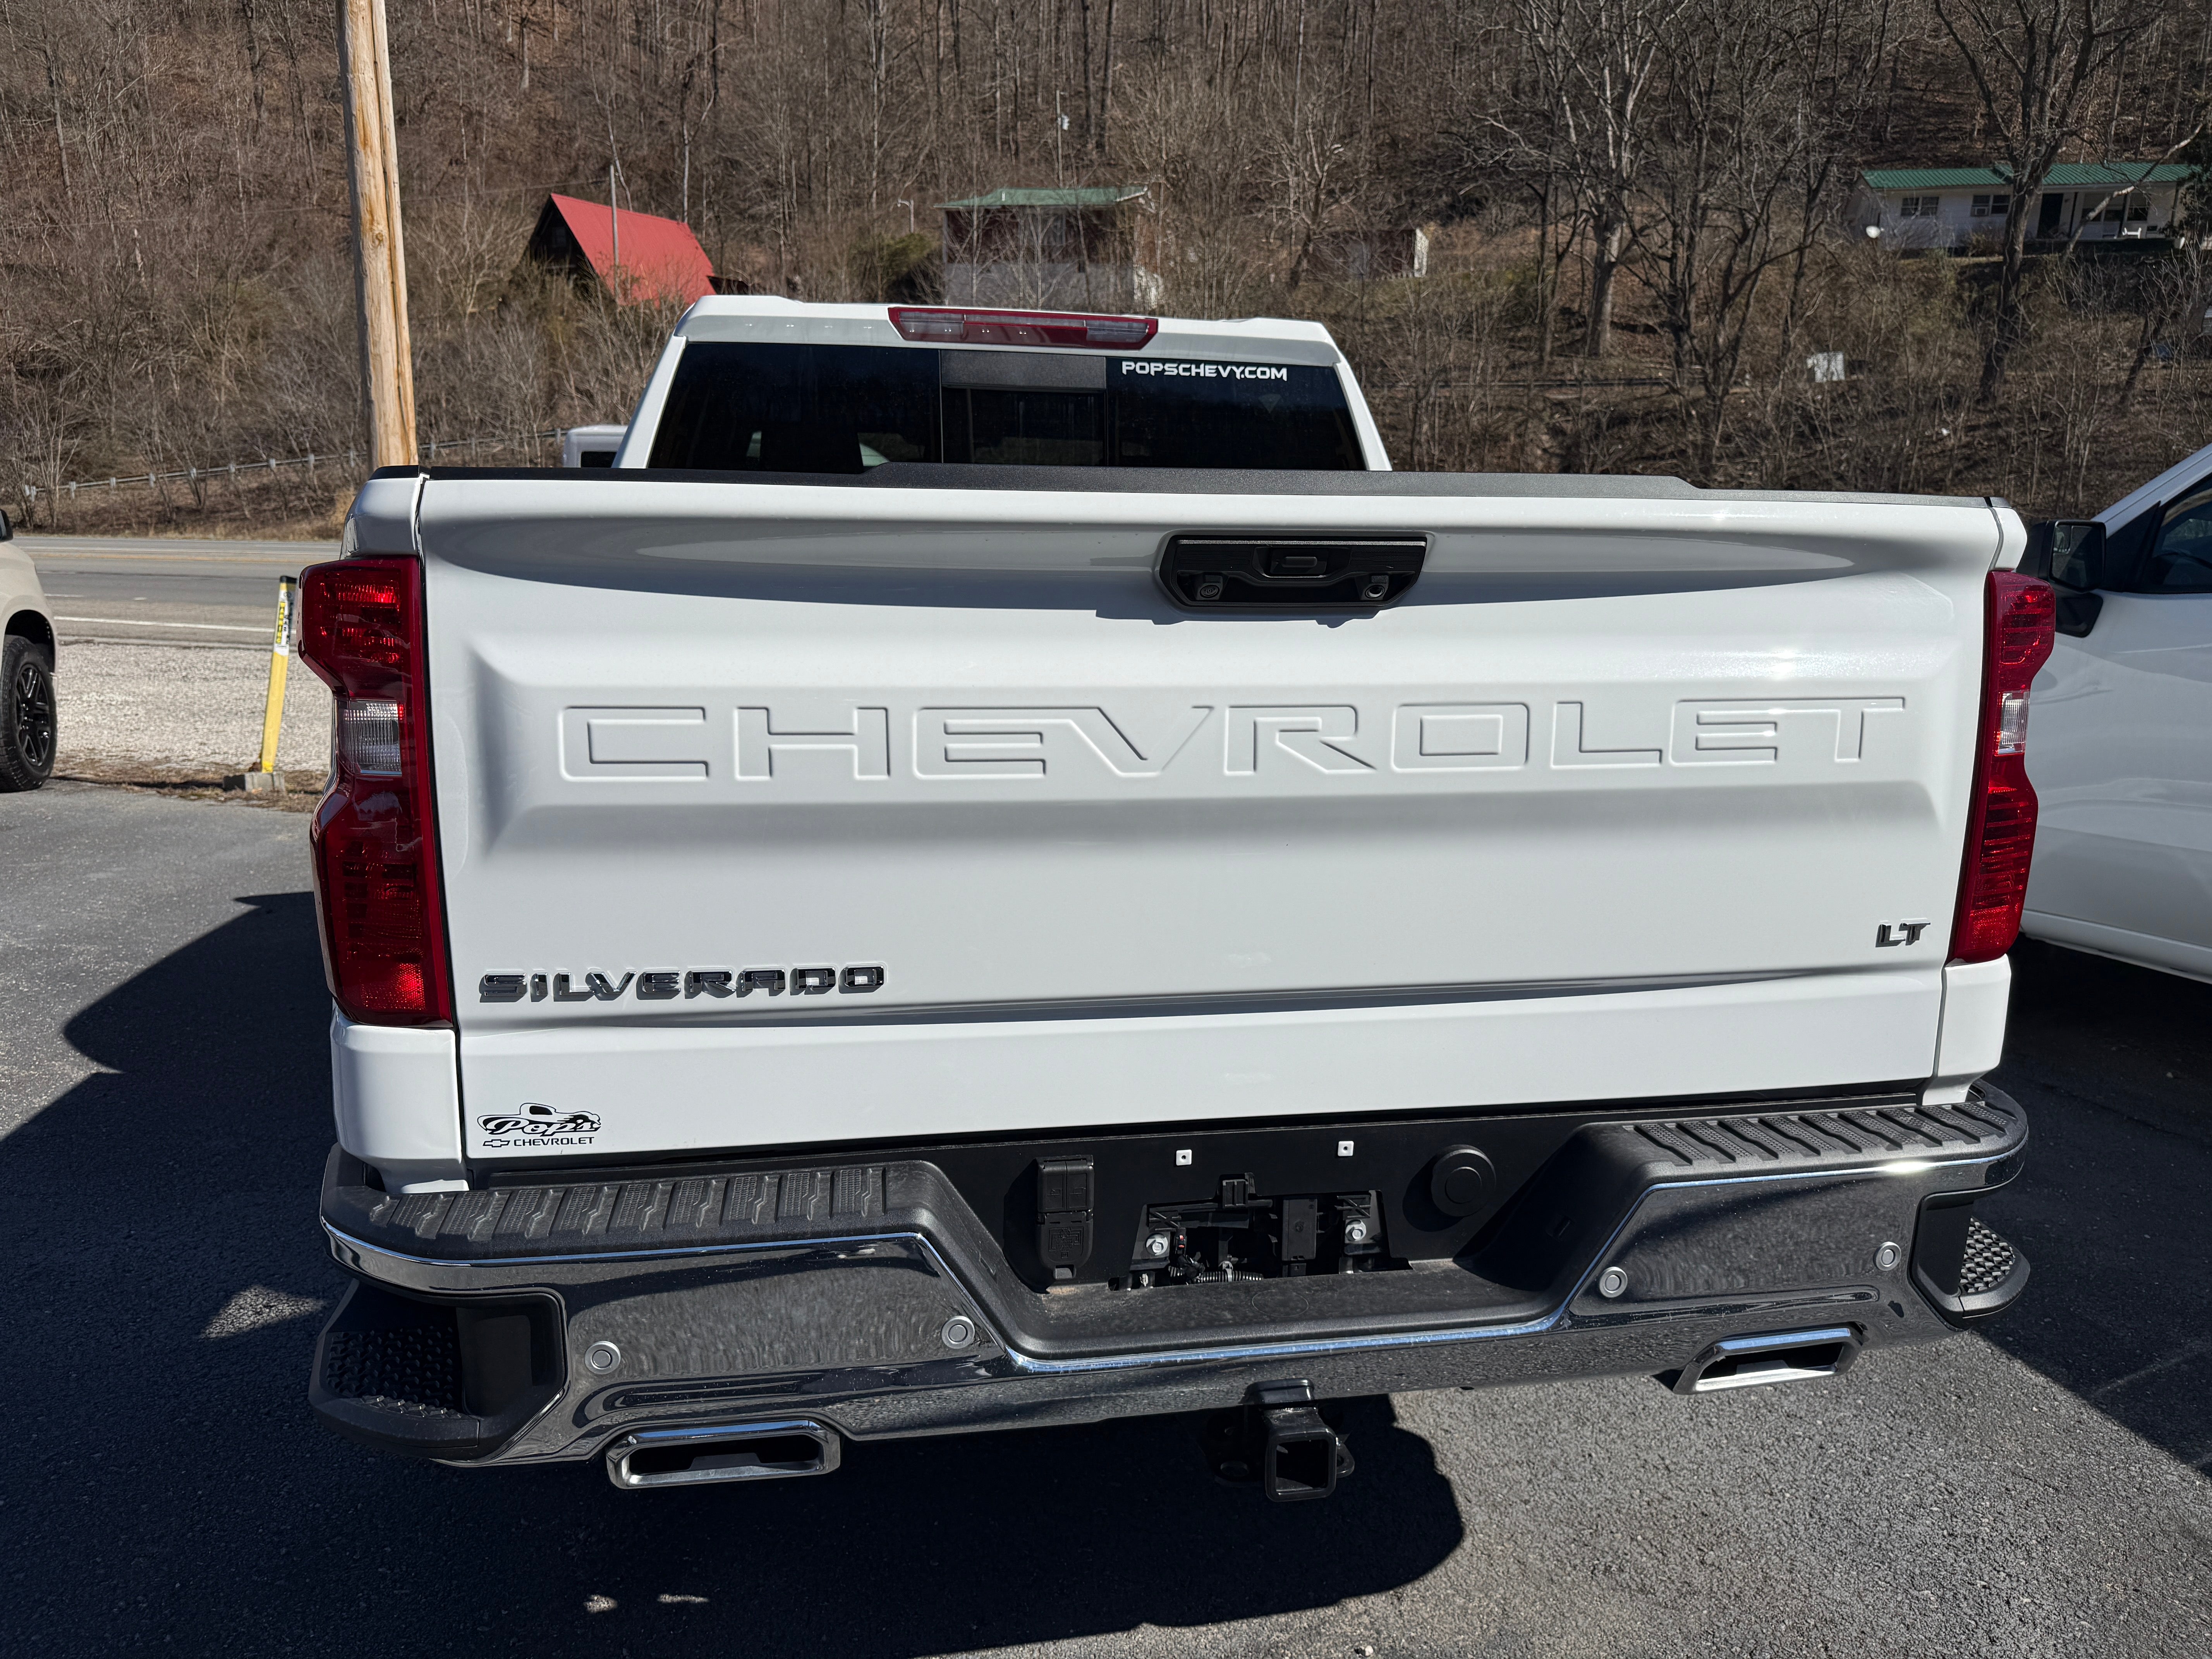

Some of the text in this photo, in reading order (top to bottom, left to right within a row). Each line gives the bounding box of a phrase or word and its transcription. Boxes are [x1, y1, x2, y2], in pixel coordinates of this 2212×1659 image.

[1122, 361, 1287, 381] POPSCHEVY.COM
[558, 696, 1905, 781] CHEVROLET
[1878, 921, 1930, 944] LT
[482, 964, 884, 998] SILVERADO
[514, 1137, 594, 1146] CHEVROLET
